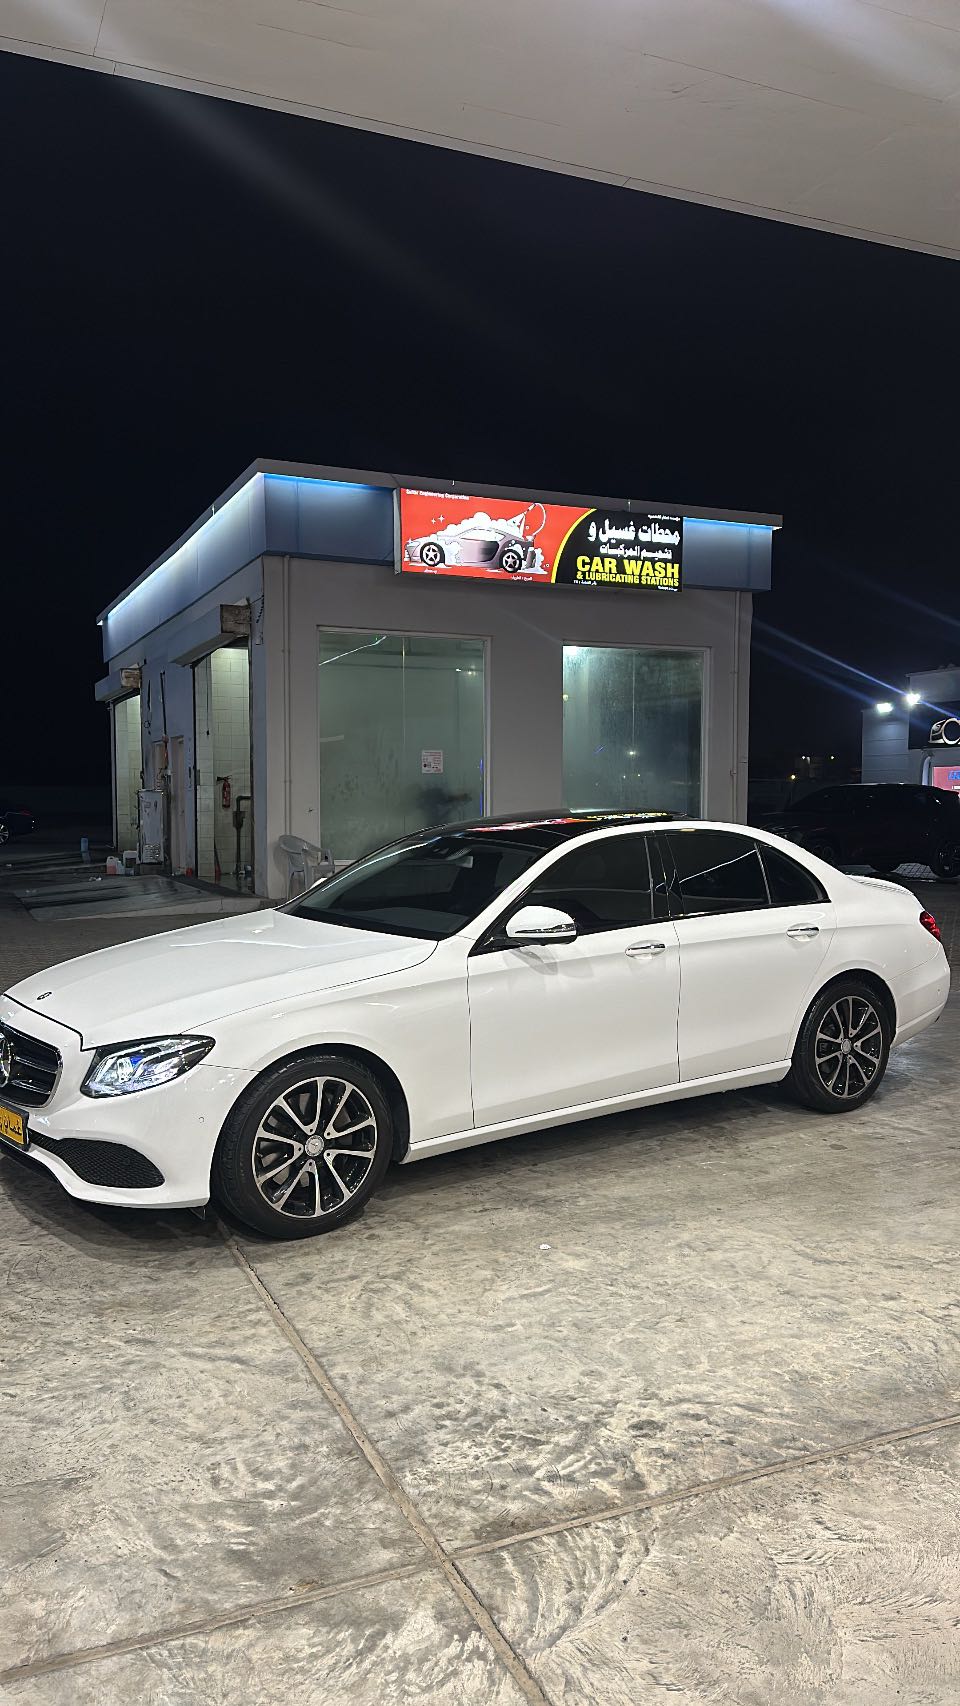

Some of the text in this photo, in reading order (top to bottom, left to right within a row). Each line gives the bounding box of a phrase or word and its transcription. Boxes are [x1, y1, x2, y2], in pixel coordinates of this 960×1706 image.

[587, 518, 680, 545] محطات غسيل و
[576, 555, 680, 578] CAR WASH
[576, 571, 583, 580] &
[585, 571, 640, 584] LUBRICATING
[641, 576, 680, 587] STATIONS
